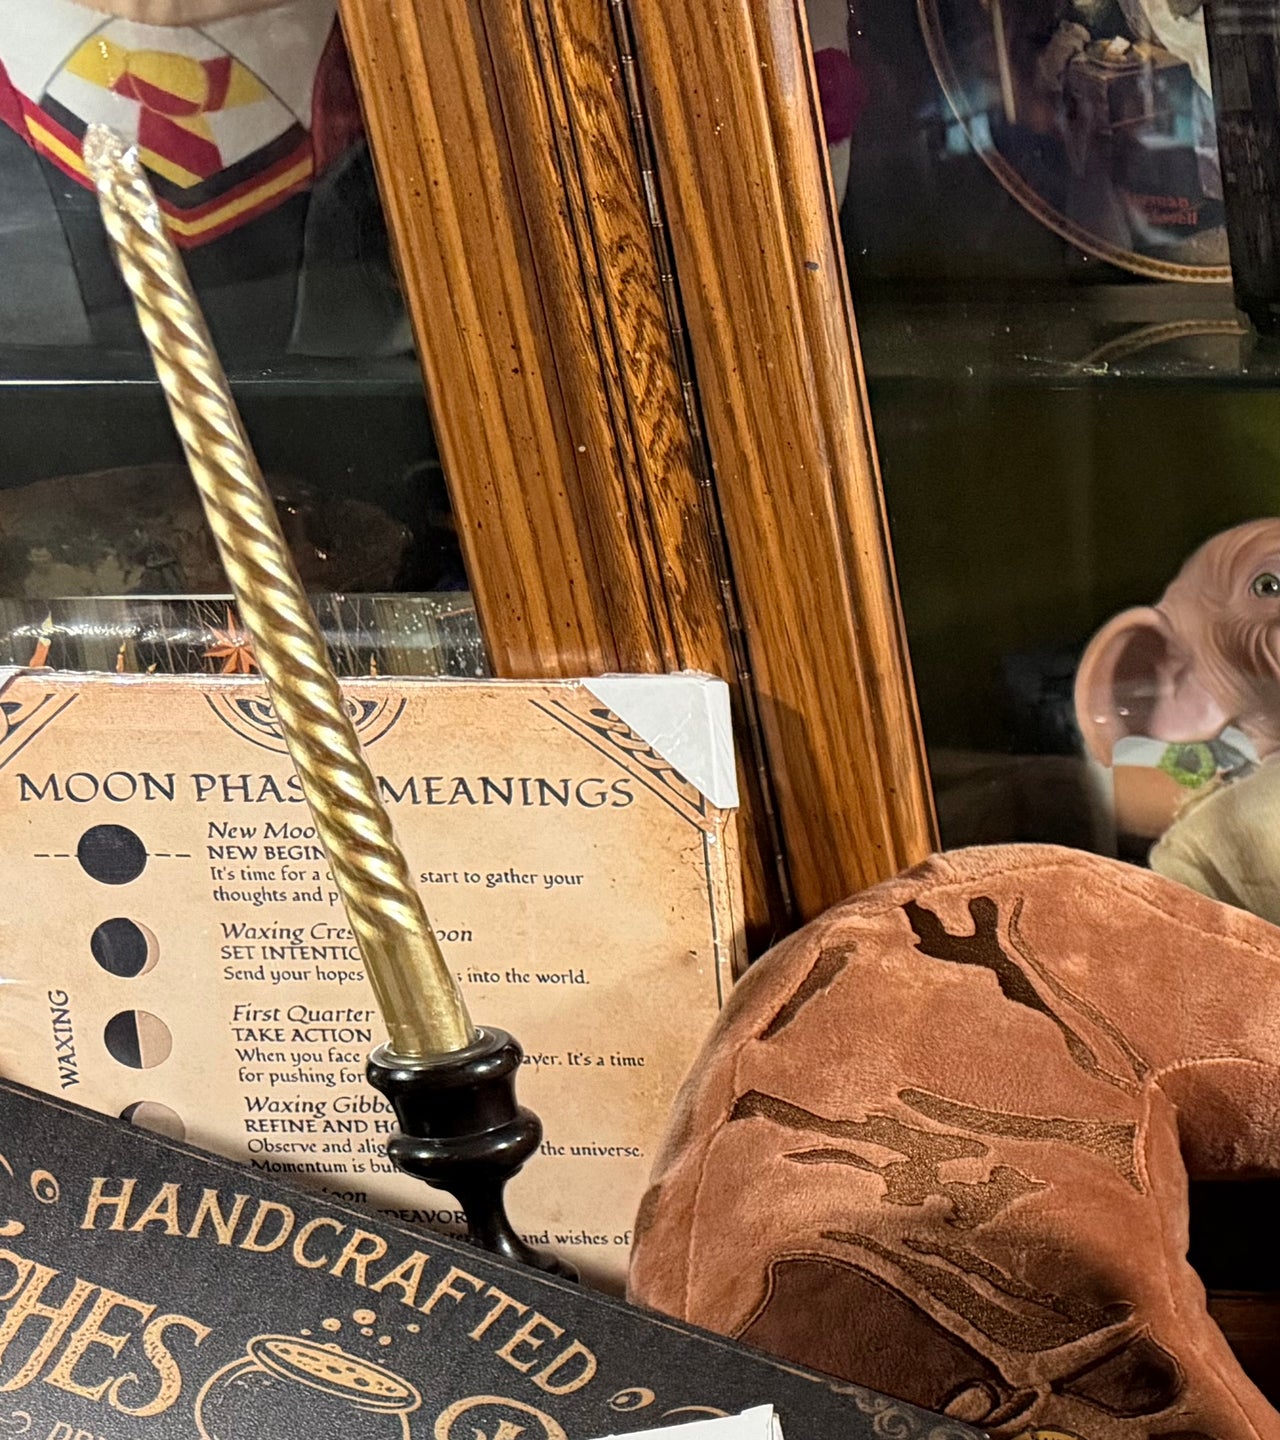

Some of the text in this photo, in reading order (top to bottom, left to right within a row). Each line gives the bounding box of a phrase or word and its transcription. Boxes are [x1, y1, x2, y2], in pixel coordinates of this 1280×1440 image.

[16, 771, 634, 808] MOON PHAS MEANINGS
[207, 821, 318, 840] New Moo
[207, 845, 262, 861] NEW
[210, 866, 236, 881] It's
[240, 867, 277, 881] time
[281, 865, 307, 881] for
[312, 870, 321, 881] a
[420, 868, 584, 888] start to gather your
[213, 886, 288, 906] thoughts
[292, 887, 325, 902] and
[220, 922, 306, 945] Waxing
[220, 946, 254, 961] SET
[223, 965, 590, 985] Send your hopes into the world.
[232, 1003, 376, 1025] First Quarter
[47, 988, 80, 1090] WAXING
[232, 1028, 372, 1043] TAKE ACTION
[235, 1047, 286, 1063] When
[291, 1051, 323, 1067] you
[328, 1047, 361, 1063] face
[567, 1053, 593, 1067] It's
[596, 1057, 605, 1067] a
[610, 1054, 645, 1067] time
[238, 1067, 264, 1083] for
[269, 1067, 337, 1088] pushing
[244, 1095, 328, 1119] Waxing
[244, 1118, 317, 1133] REFINE
[322, 1119, 369, 1133] AND
[247, 1138, 645, 1158] Observe and the universe.
[251, 1158, 348, 1174] Momentum
[352, 1158, 366, 1173] is
[556, 1231, 609, 1246] wishes
[613, 1230, 633, 1245] of
[80, 1176, 599, 1396] HANDCRAFTED
